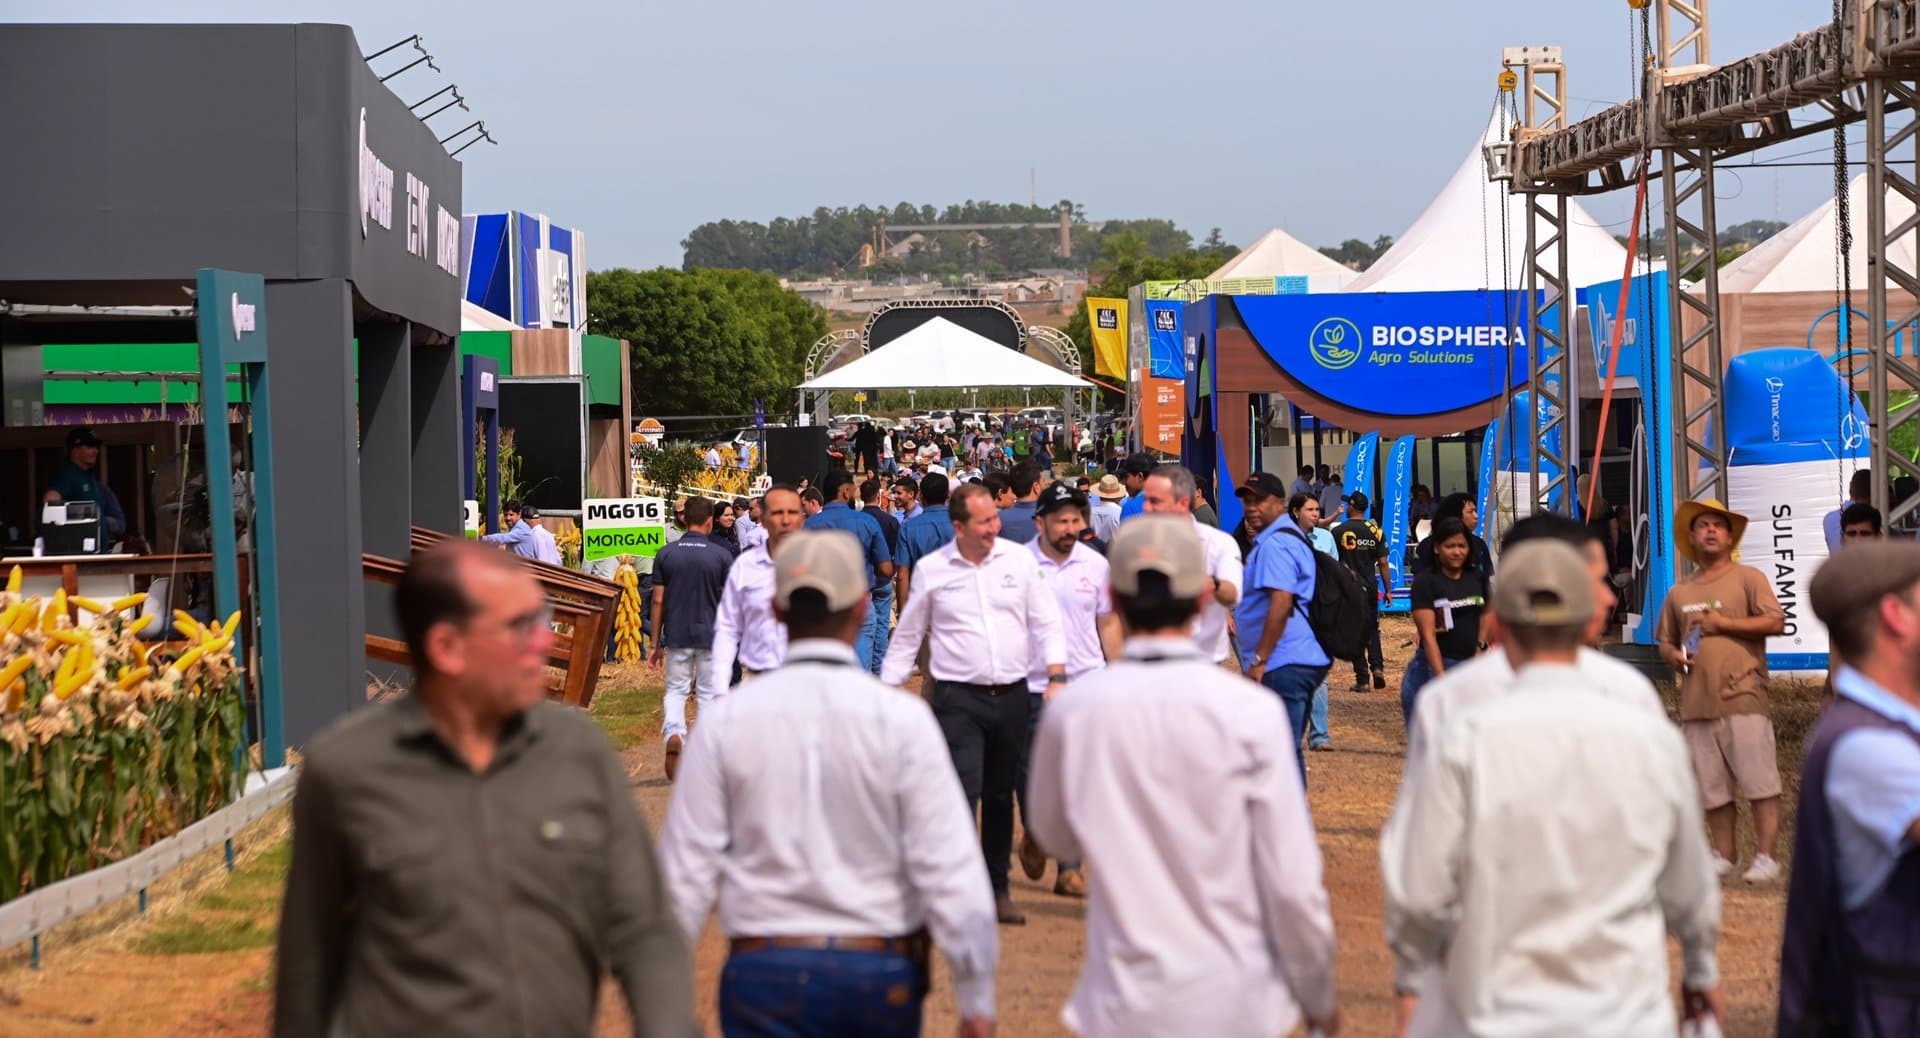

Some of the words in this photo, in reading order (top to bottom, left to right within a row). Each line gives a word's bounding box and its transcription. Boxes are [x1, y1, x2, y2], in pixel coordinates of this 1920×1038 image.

[1372, 325, 1527, 346] BIOSPHERA
[1368, 350, 1402, 366] Agro
[1408, 350, 1474, 364] Solutions
[1395, 441, 1406, 488] AGRO
[587, 502, 659, 520] MG616
[1390, 488, 1402, 546] Timac
[586, 531, 660, 548] MORGAN
[1356, 539, 1376, 547] GOLD
